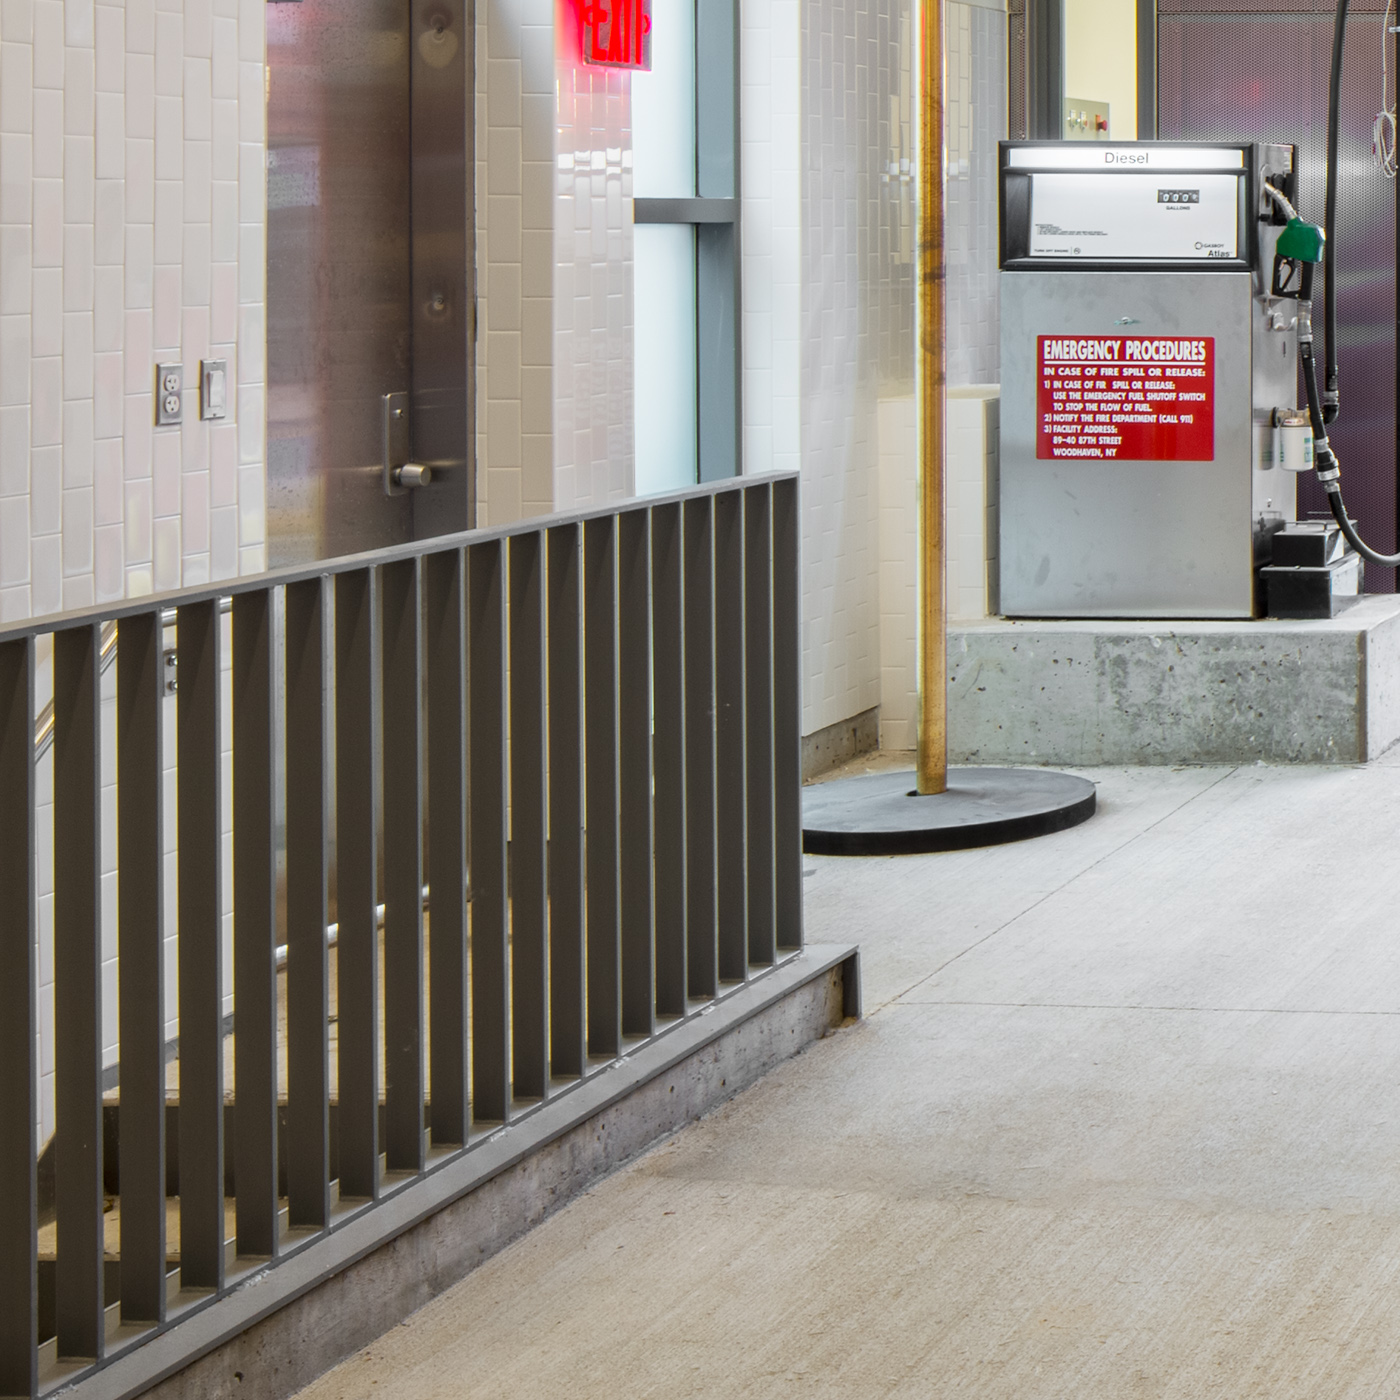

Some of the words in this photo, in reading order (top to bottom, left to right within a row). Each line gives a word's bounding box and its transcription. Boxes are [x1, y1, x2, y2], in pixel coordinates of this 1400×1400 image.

[1105, 152, 1149, 164] Diesel
[1208, 249, 1230, 258] Atlas
[1043, 339, 1121, 360] EMERGENCY
[1125, 340, 1206, 361] PROCEDURES
[1043, 367, 1055, 377] IN
[1057, 367, 1082, 377] CASE
[1084, 367, 1098, 377] OF
[1100, 367, 1120, 377] FIRE
[1122, 367, 1146, 377] SPILL
[1147, 367, 1163, 377] OR
[1165, 367, 1206, 377] RELEASE:
[1043, 380, 1051, 390] 1)
[1053, 380, 1063, 390] IN
[1063, 380, 1082, 390] CASE
[1083, 380, 1094, 390] OF
[1095, 380, 1107, 390] FIR
[1112, 380, 1130, 390] SPILL
[1131, 380, 1143, 390] OR
[1144, 380, 1176, 390] RELEASE:
[1053, 391, 1067, 400] USE
[1068, 391, 1082, 400] THE
[1083, 391, 1127, 400] EMERGENCY
[1128, 391, 1145, 401] FUEL
[1146, 391, 1177, 401] SHUTOFF
[1178, 391, 1206, 401] SWITCH
[1053, 402, 1064, 412] TO
[1065, 402, 1084, 412] STOP
[1085, 402, 1099, 412] THE
[1100, 402, 1121, 412] FLOW
[1122, 402, 1133, 412] OF
[1134, 402, 1153, 412] FUEL.
[1043, 413, 1052, 422] 2)
[1053, 413, 1079, 422] NOTIFY
[1080, 413, 1094, 422] THE
[1095, 413, 1111, 422] FIRE
[1112, 413, 1157, 423] DEPARTMENT
[1158, 413, 1178, 424] (CALL
[1179, 413, 1194, 424] 911)
[1043, 424, 1052, 434] 3)
[1053, 424, 1082, 434] FACILITY
[1083, 424, 1118, 434] ADDRESS:
[1053, 436, 1076, 445] 89-40
[1078, 436, 1097, 445] 87TH
[1098, 436, 1122, 445] STREET
[1053, 448, 1104, 458] WOODHAVEN,
[1105, 448, 1118, 457] NY
